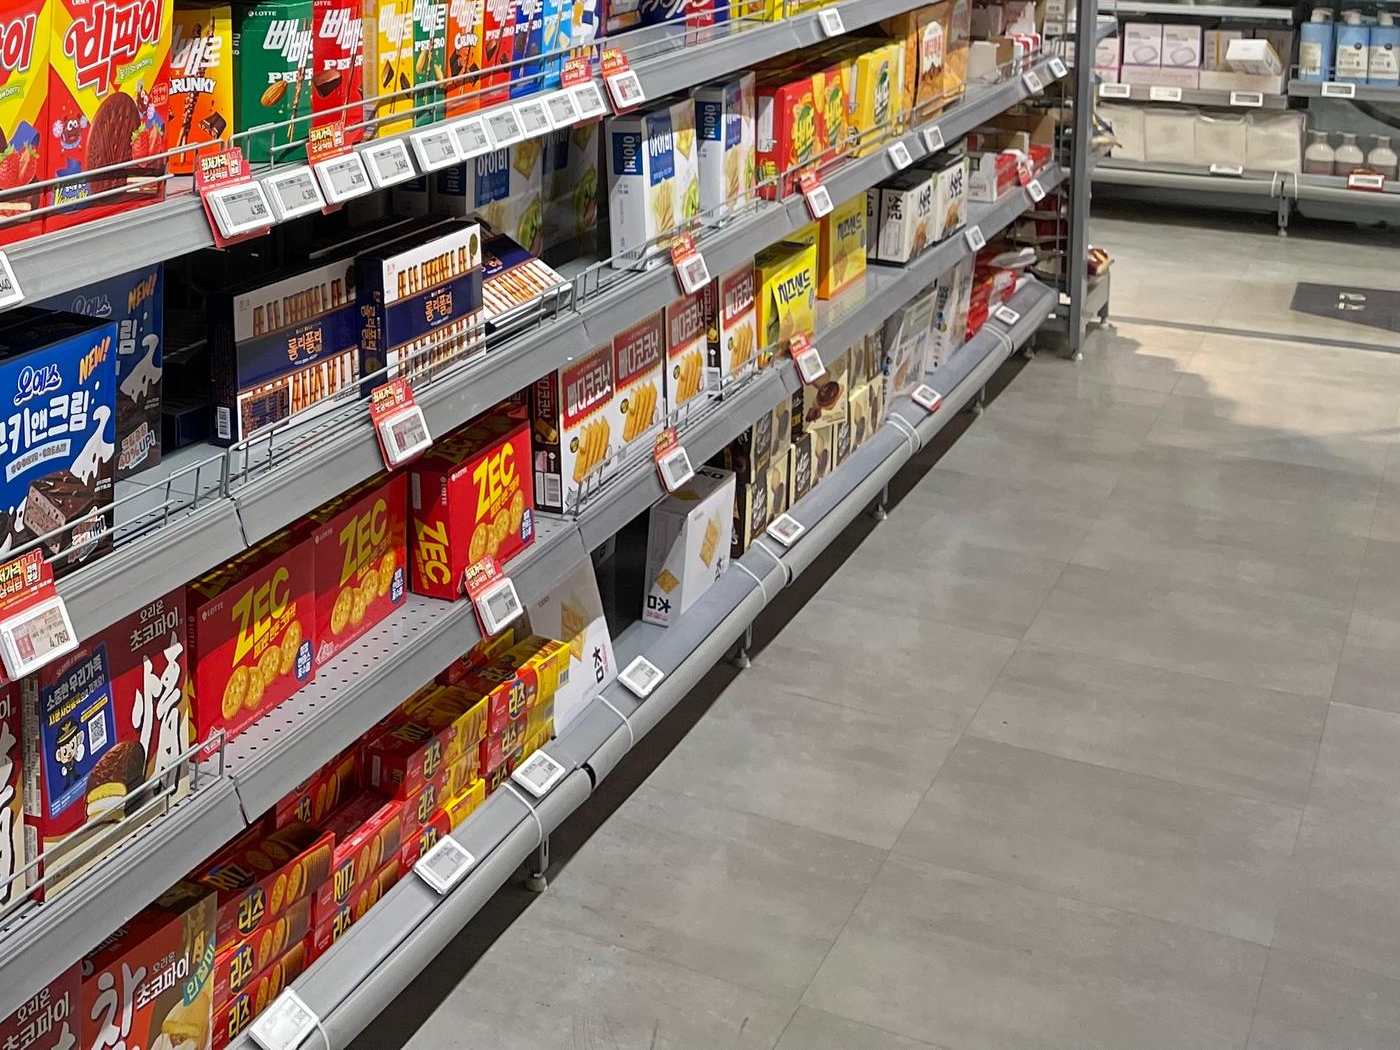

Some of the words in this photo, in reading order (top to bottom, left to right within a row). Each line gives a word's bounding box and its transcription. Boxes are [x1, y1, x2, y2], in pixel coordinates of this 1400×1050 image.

[128, 274, 158, 314] NEW!
[79, 335, 112, 384] NEW!
[13, 362, 63, 406] 오예스
[472, 442, 515, 524] ZEC
[339, 498, 388, 589] ZEC
[413, 517, 452, 587] ZEC
[130, 609, 180, 653] 초코파이
[139, 600, 165, 624] 오리온
[232, 566, 290, 669] ZEC
[423, 739, 442, 779] 리즈
[332, 857, 356, 905] RITZ
[238, 887, 265, 933] 리즈
[136, 953, 190, 1009] 초코파이
[230, 943, 255, 991] 리즈
